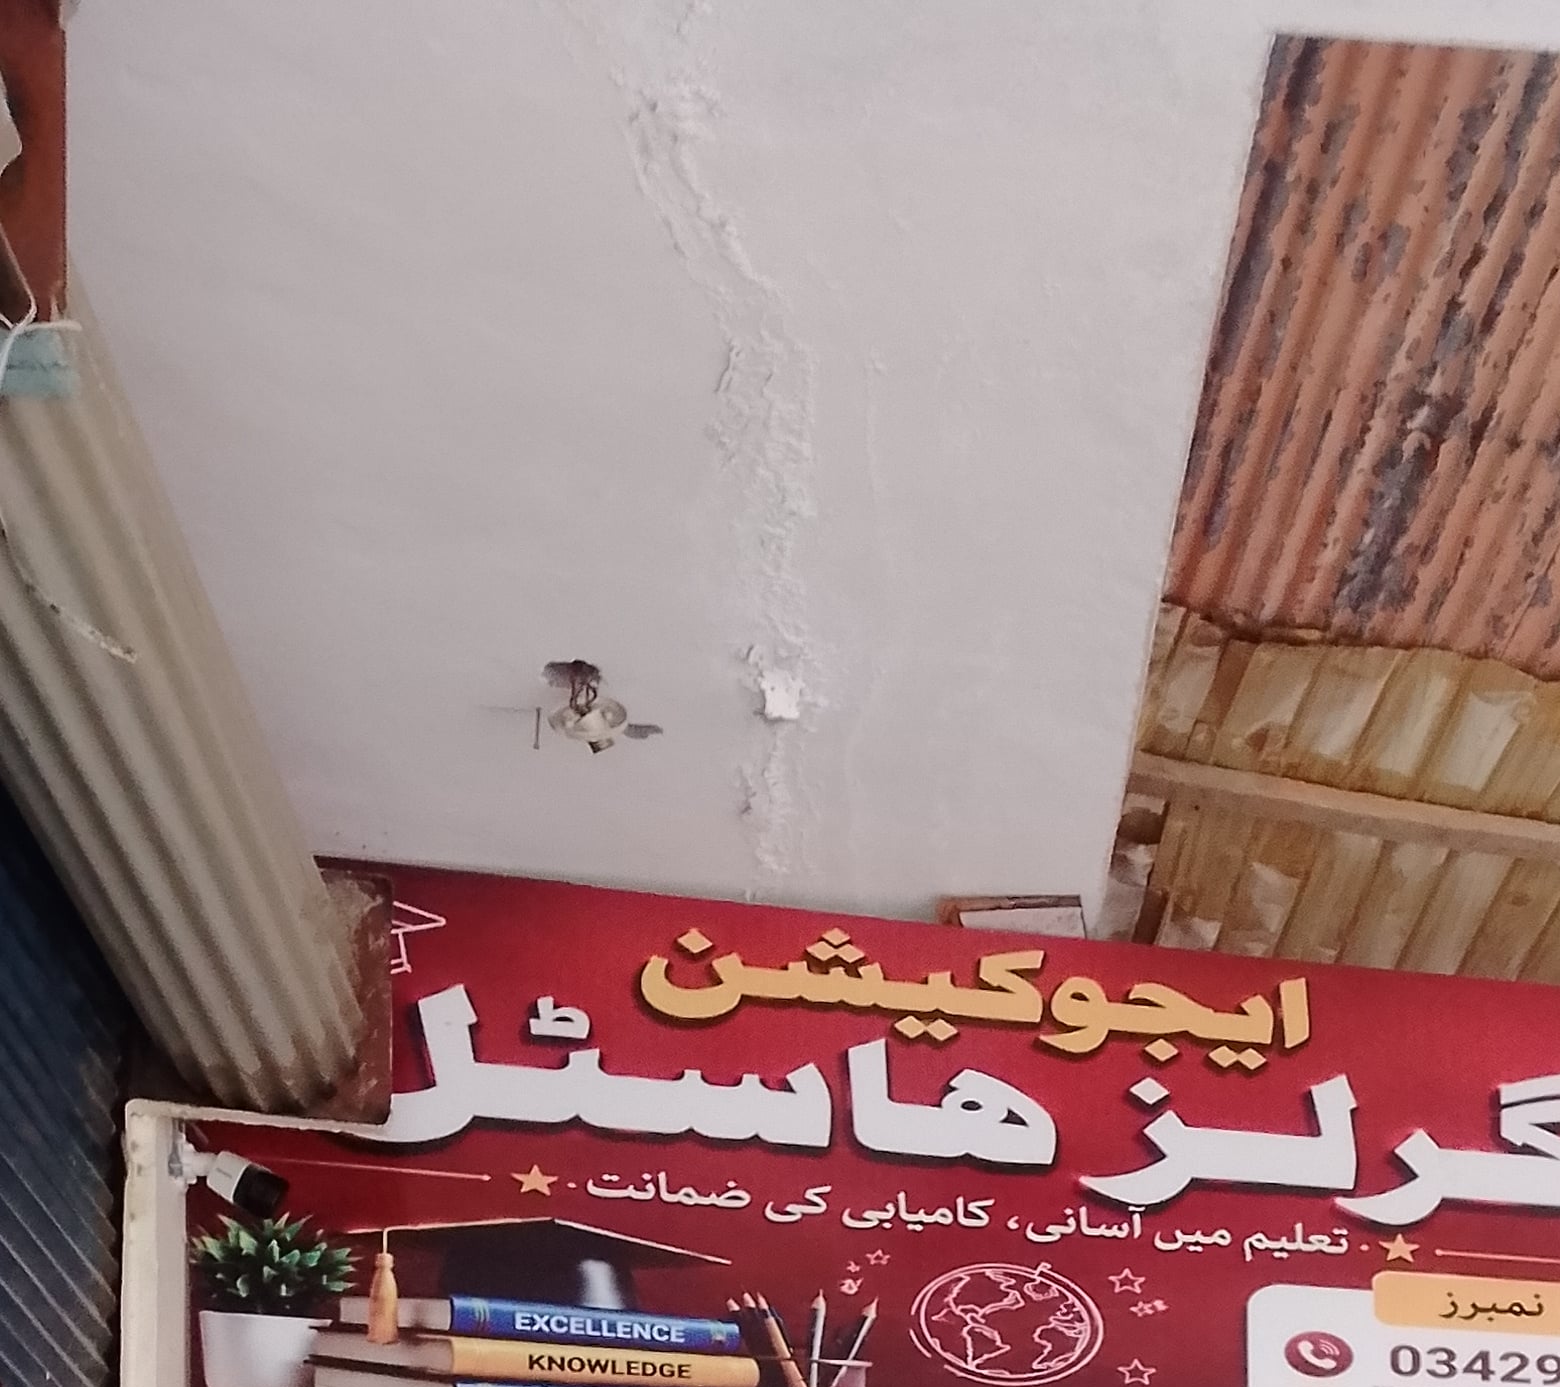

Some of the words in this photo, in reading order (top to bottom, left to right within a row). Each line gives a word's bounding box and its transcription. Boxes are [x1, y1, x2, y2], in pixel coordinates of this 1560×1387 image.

[642, 927, 1310, 1072] ایجوکیشن
[586, 1171, 752, 1209] ضمانت
[764, 1185, 832, 1223] کی
[842, 1191, 996, 1232] کامیابی
[1154, 1226, 1232, 1252] میں
[1241, 1223, 1350, 1261] تعلیم
[513, 1310, 687, 1345] EXCELLENCE
[1438, 1292, 1542, 1325] نمبرز
[526, 1352, 692, 1381] KNOWLEDGE
